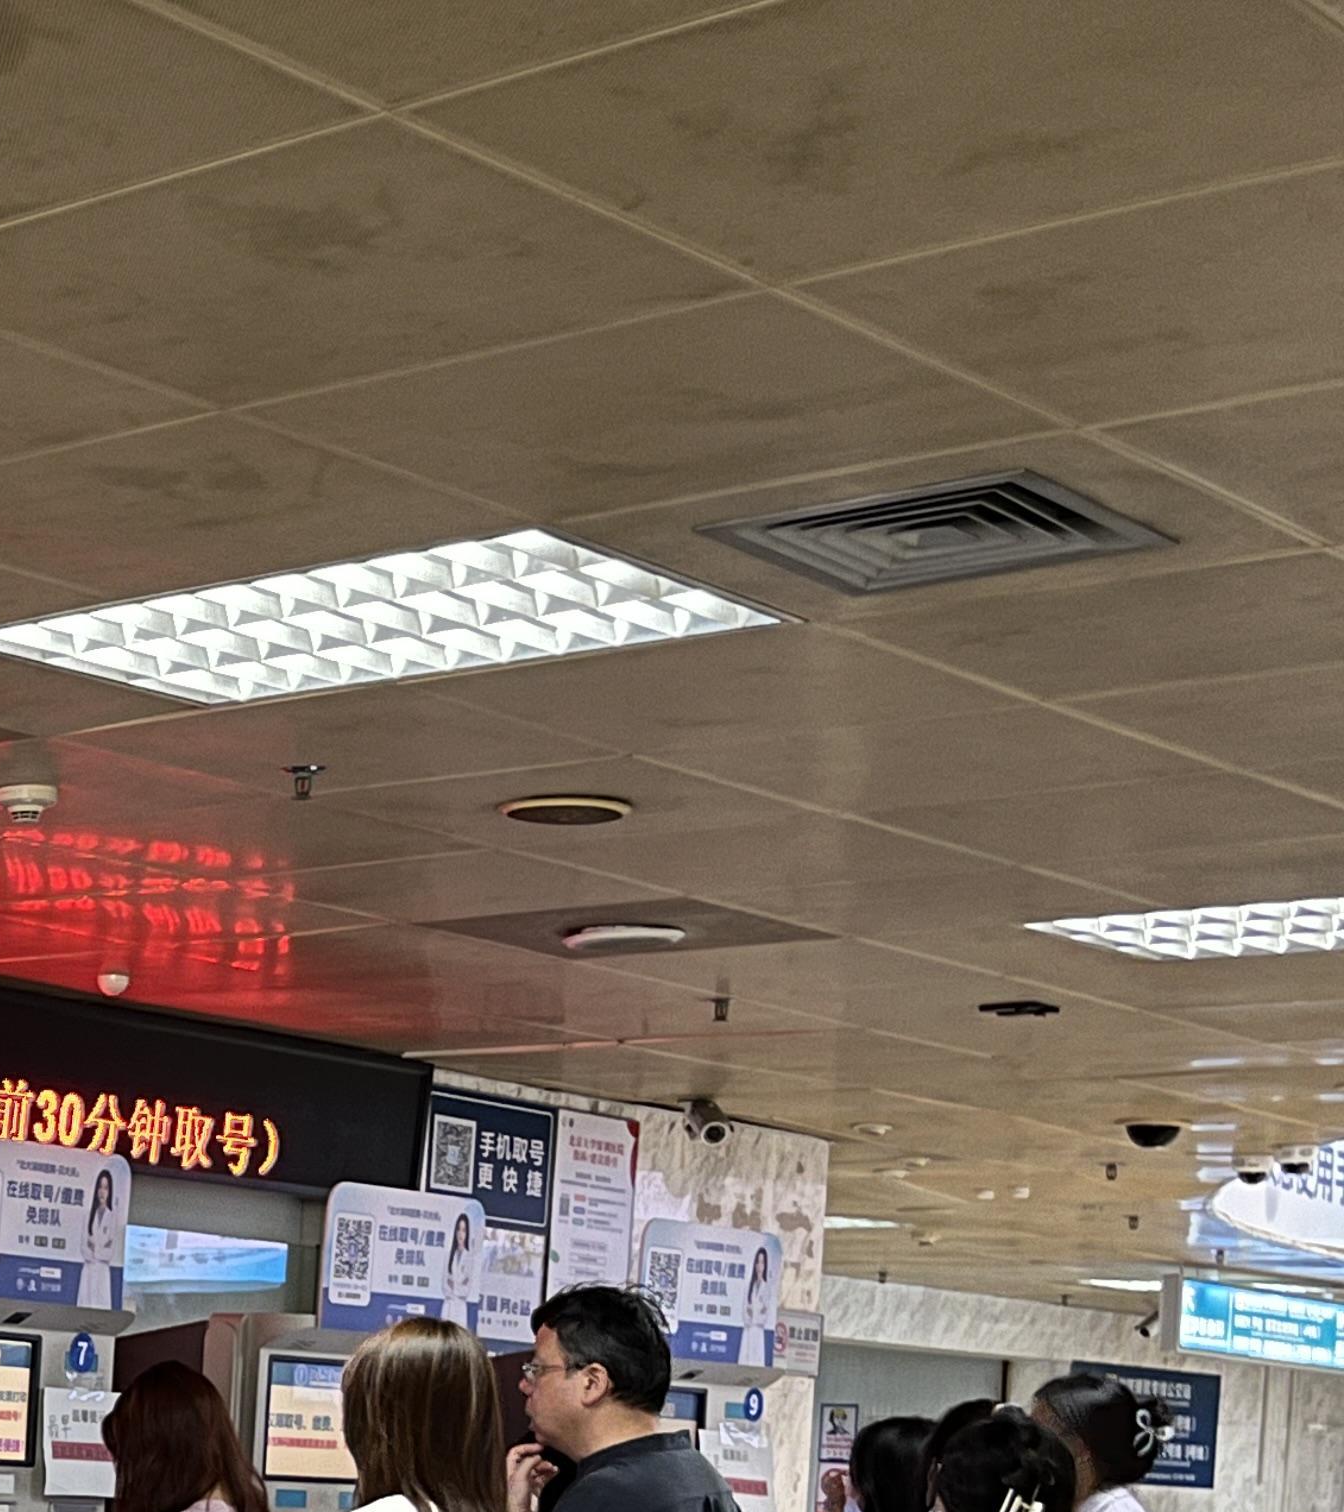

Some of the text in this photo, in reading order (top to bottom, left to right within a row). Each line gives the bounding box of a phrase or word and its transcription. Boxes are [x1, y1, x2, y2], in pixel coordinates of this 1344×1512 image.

[479, 1131, 545, 1167] 手机取号
[77, 1341, 88, 1366] 7
[749, 1393, 759, 1416] 9
